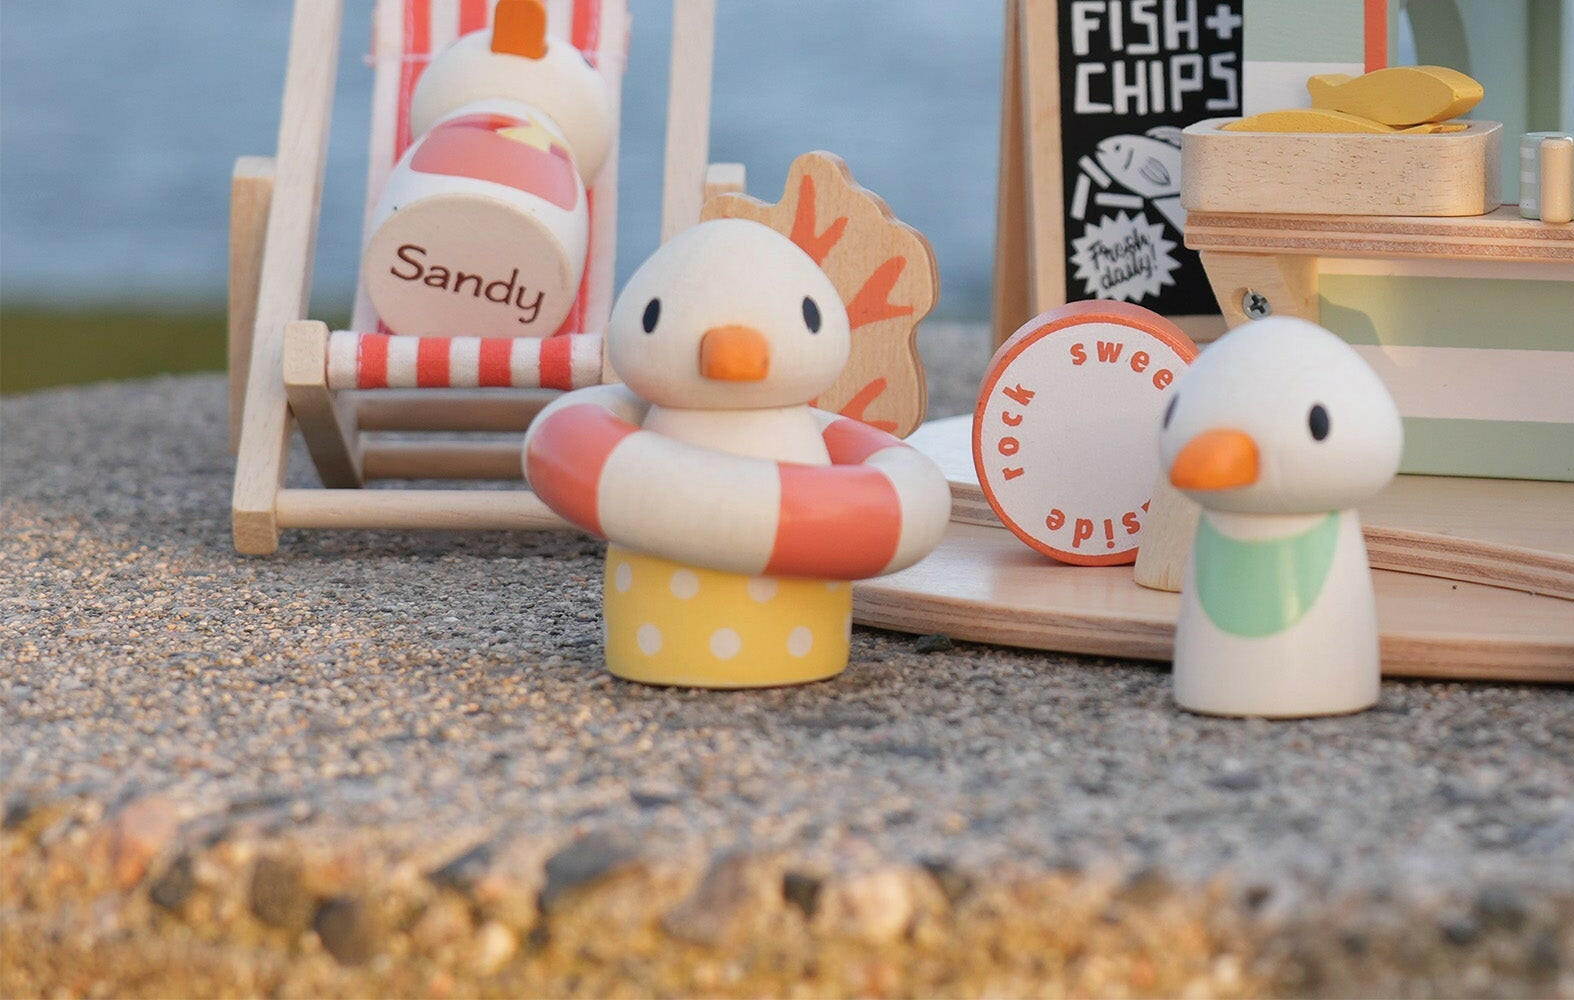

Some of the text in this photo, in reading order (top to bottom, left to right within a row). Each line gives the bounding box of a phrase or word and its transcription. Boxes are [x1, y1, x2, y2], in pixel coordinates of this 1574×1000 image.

[1074, 51, 1239, 116] CHIPS
[390, 243, 546, 324] Sandy
[998, 341, 1175, 549] swee side rock
